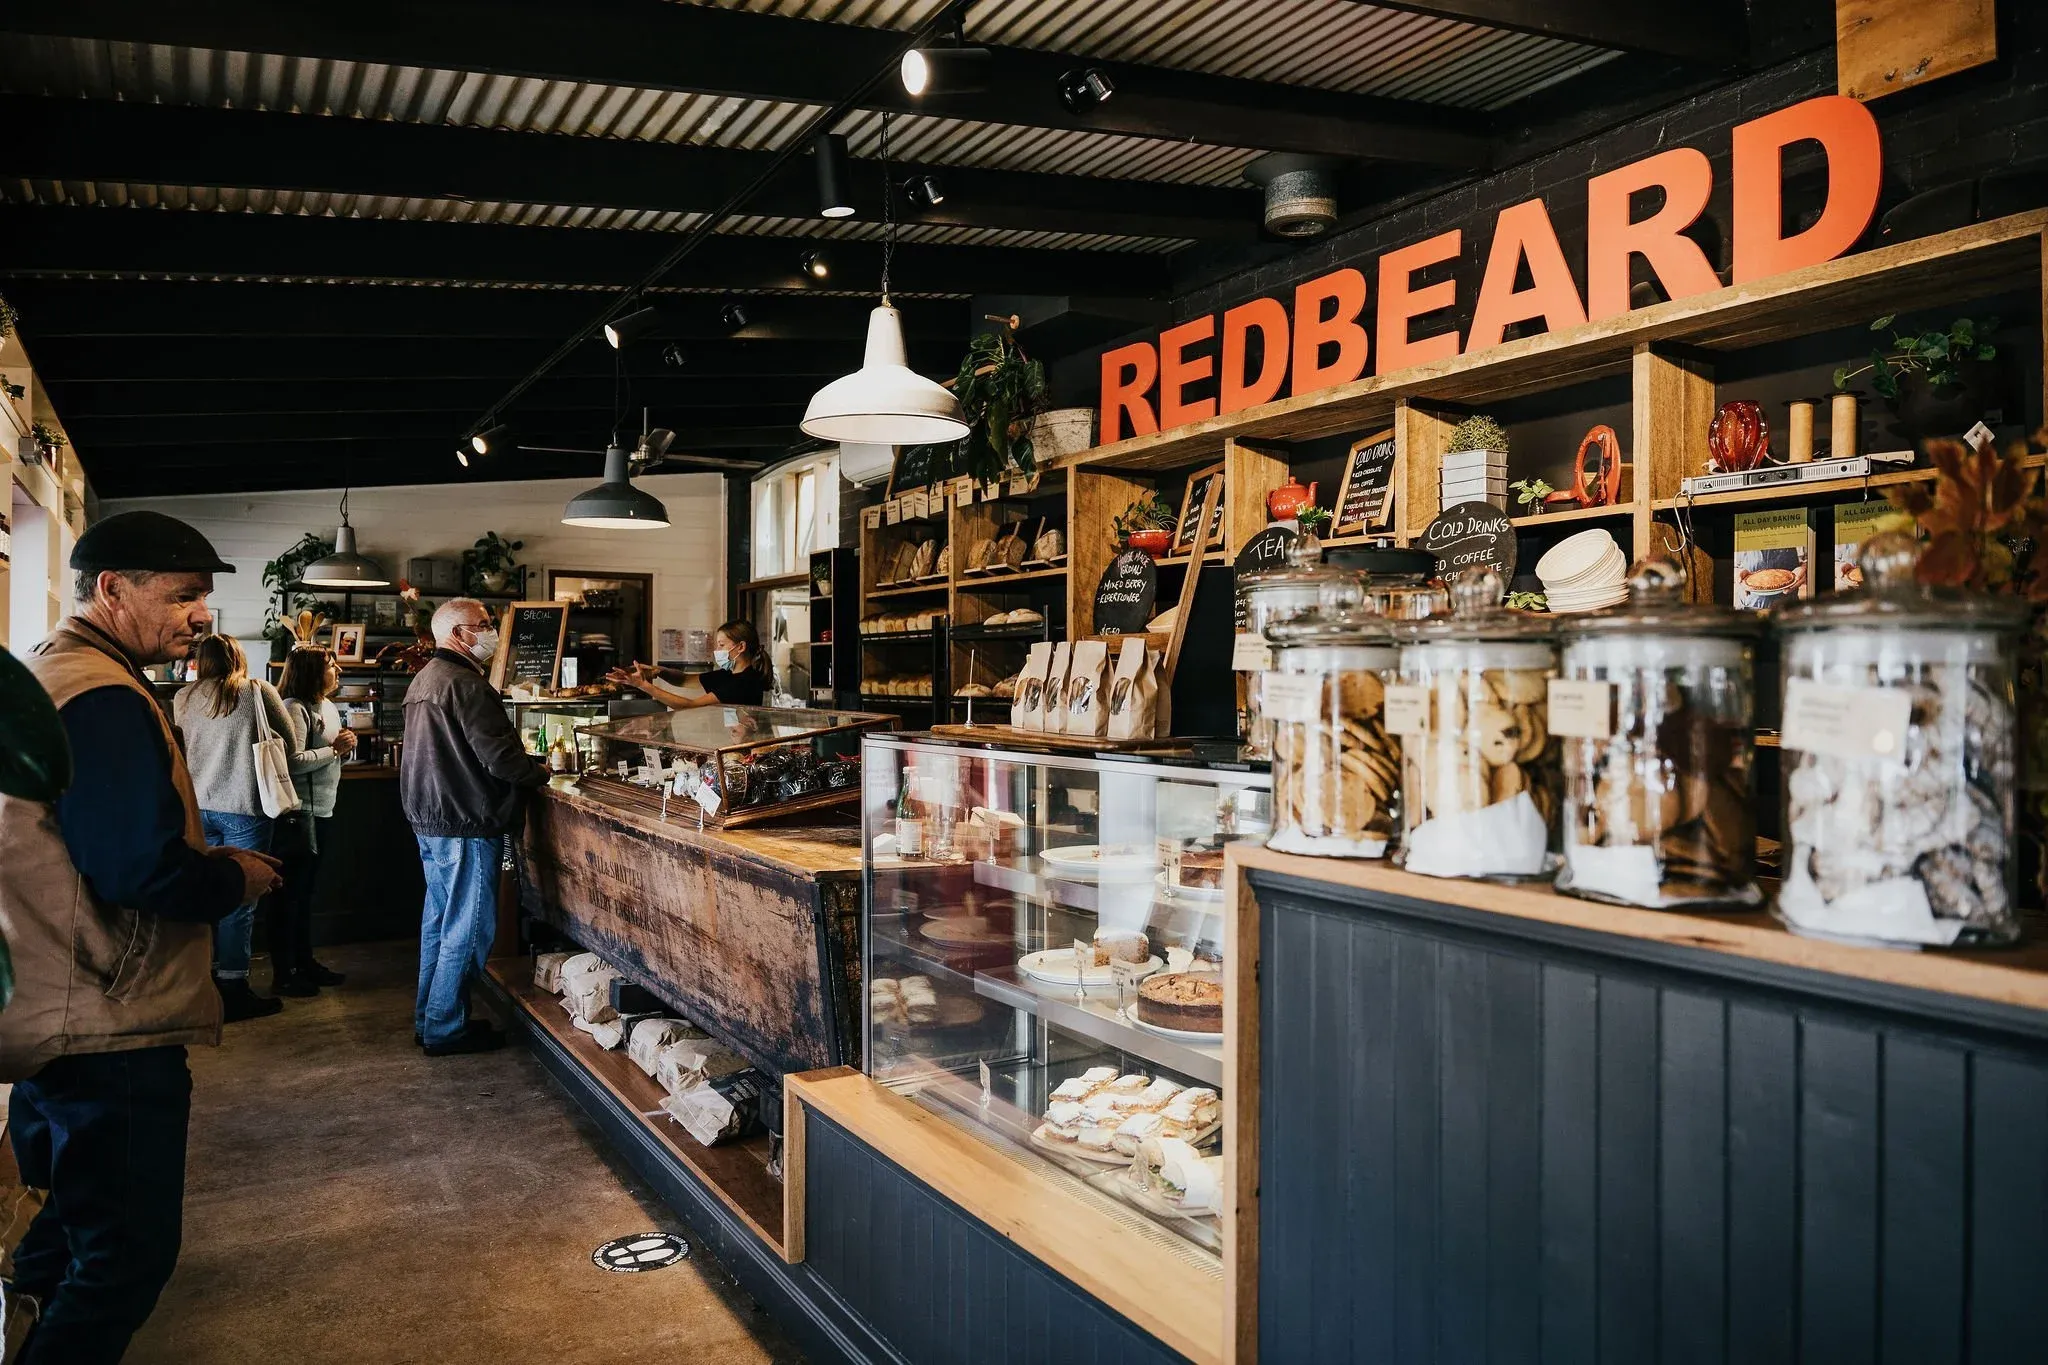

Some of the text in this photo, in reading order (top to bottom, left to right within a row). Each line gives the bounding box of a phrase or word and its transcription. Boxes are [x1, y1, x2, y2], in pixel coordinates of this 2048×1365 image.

[1099, 95, 1883, 446] REDBEARD
[1355, 448, 1372, 466] COLD
[1843, 509, 1859, 517] ALL
[1860, 507, 1876, 515] DAY
[1743, 513, 1801, 526] ALL DAY BAKING
[1429, 517, 1509, 541] COLD DRINKS
[1453, 547, 1495, 566] COFFEE
[1125, 579, 1147, 593] BERRY
[523, 610, 552, 620] SPECIAL
[667, 1234, 686, 1245] YOUR
